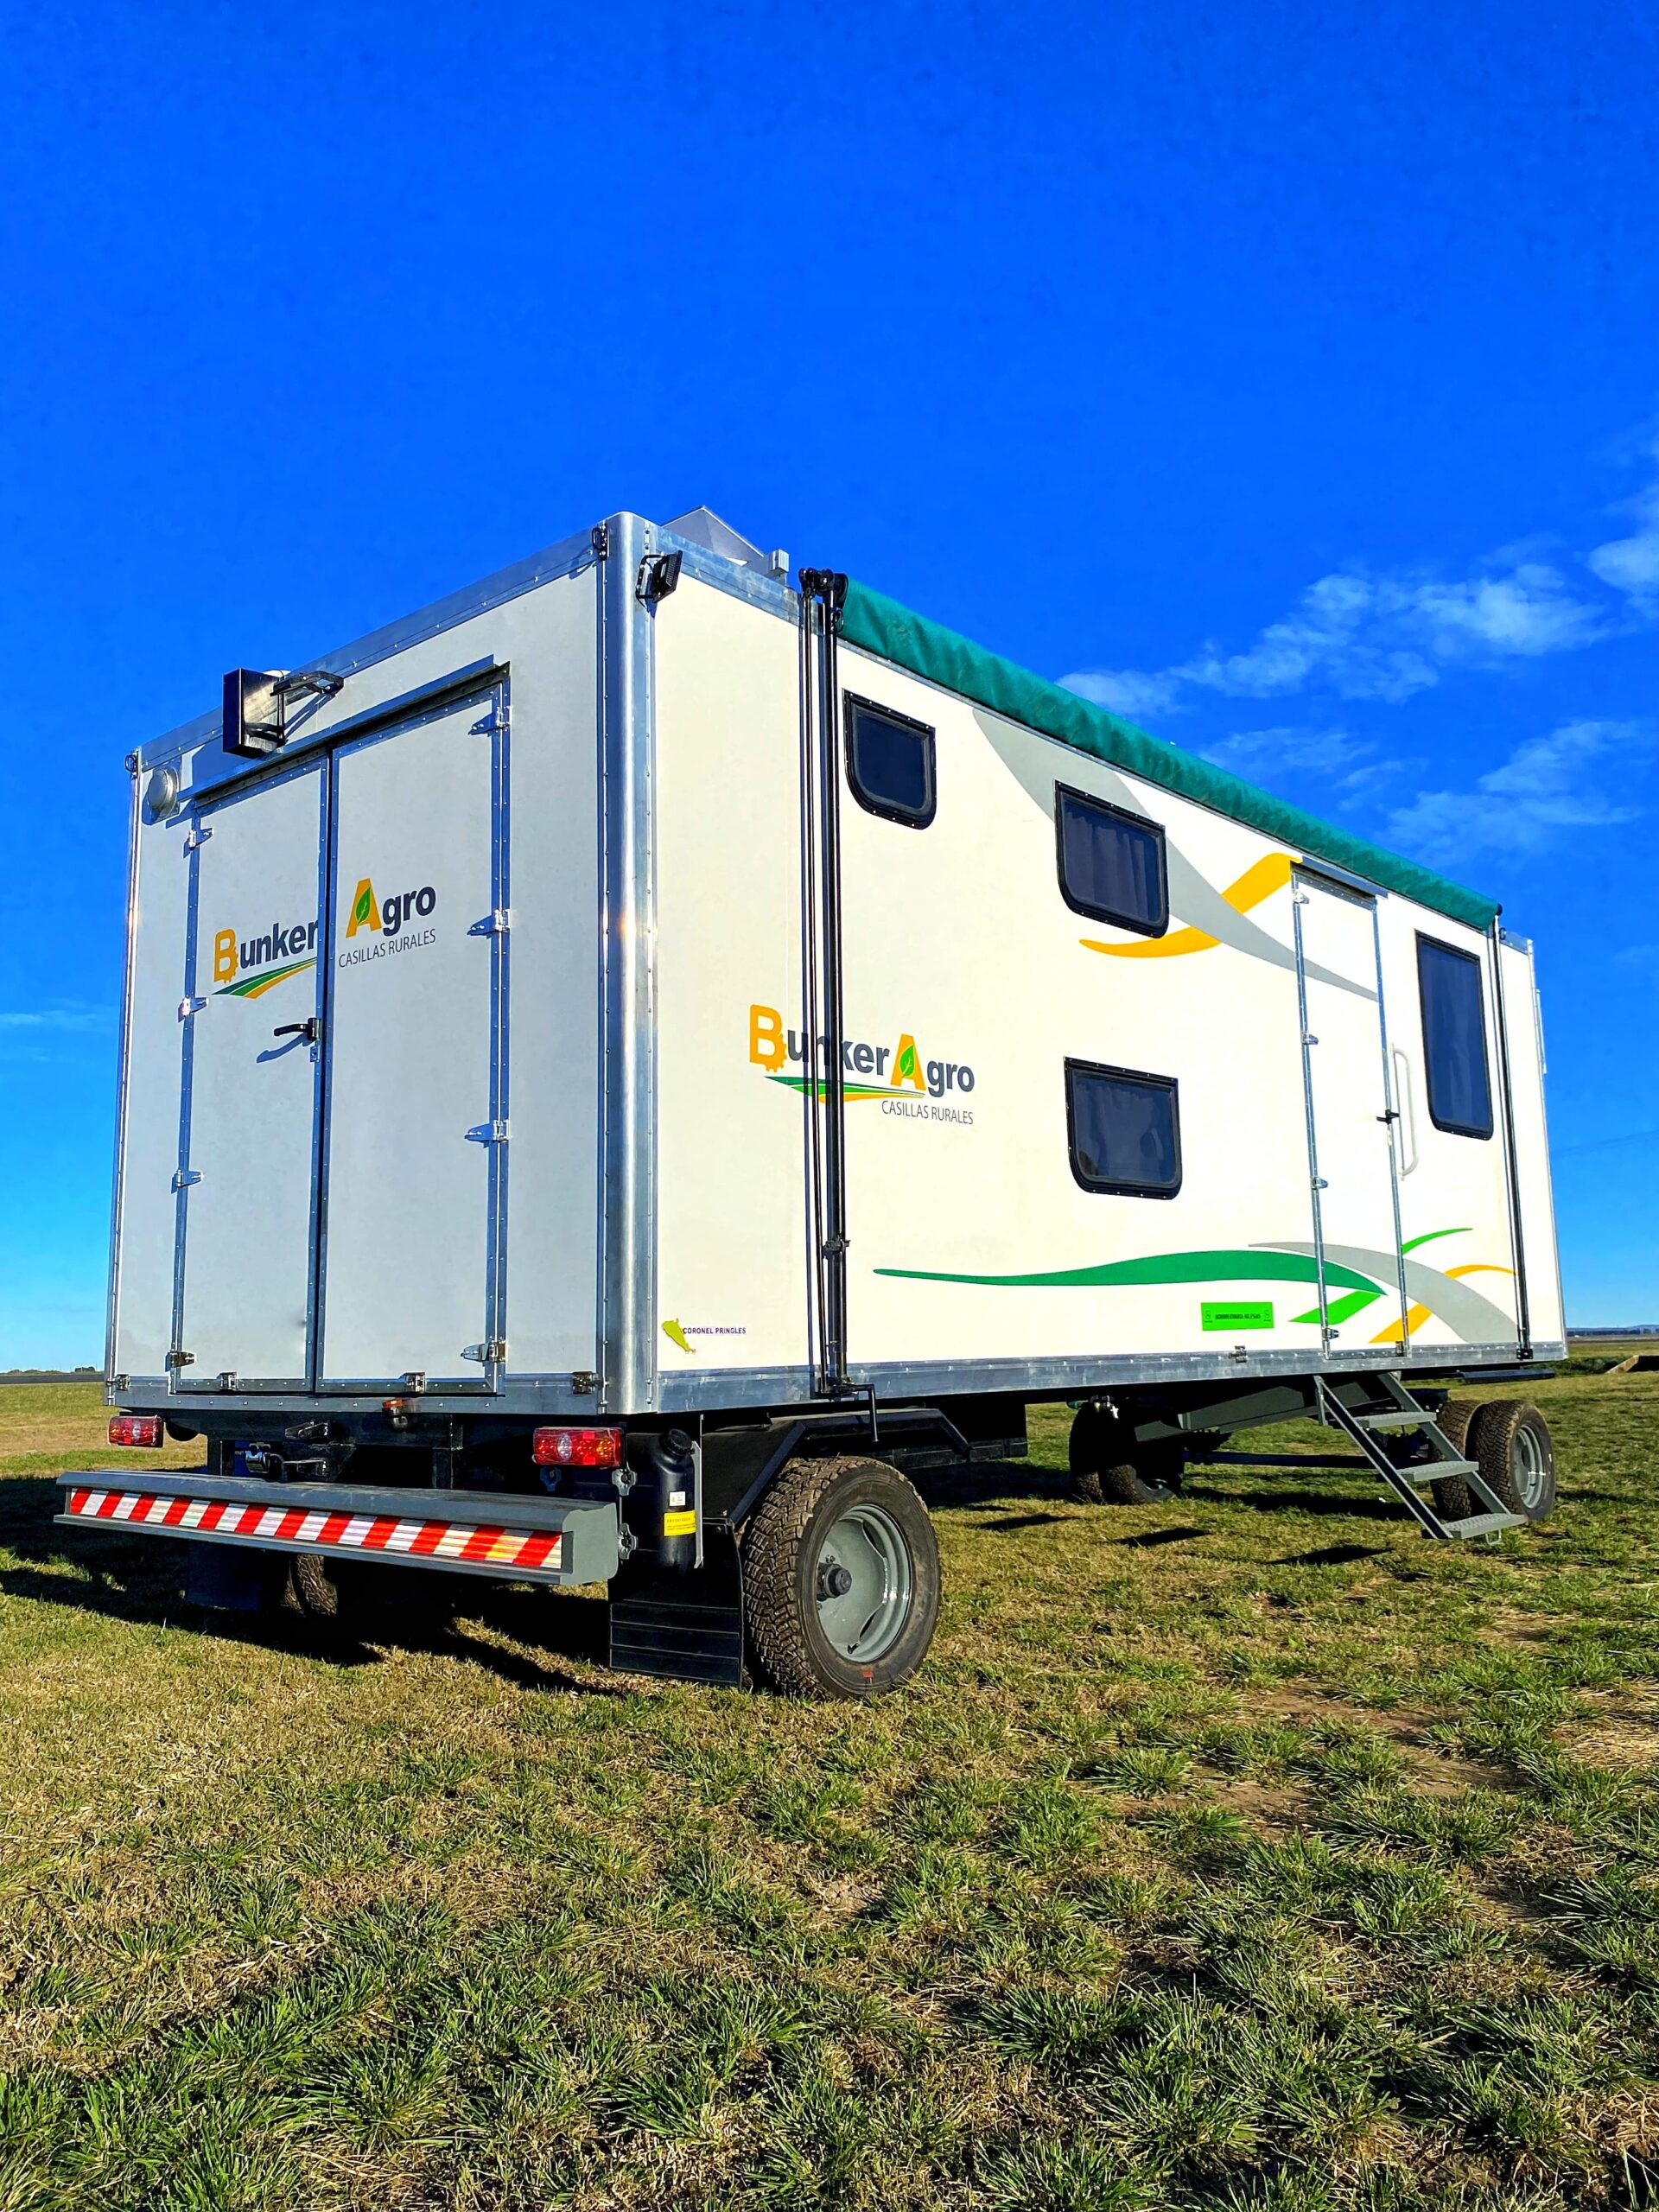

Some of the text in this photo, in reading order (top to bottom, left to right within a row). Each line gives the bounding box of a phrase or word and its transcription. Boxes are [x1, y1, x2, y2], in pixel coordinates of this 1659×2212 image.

[213, 878, 436, 983] Bunker Agro
[338, 928, 436, 969] CASILLAS RURALES
[881, 1099, 974, 1125] CASILLAS RURALES
